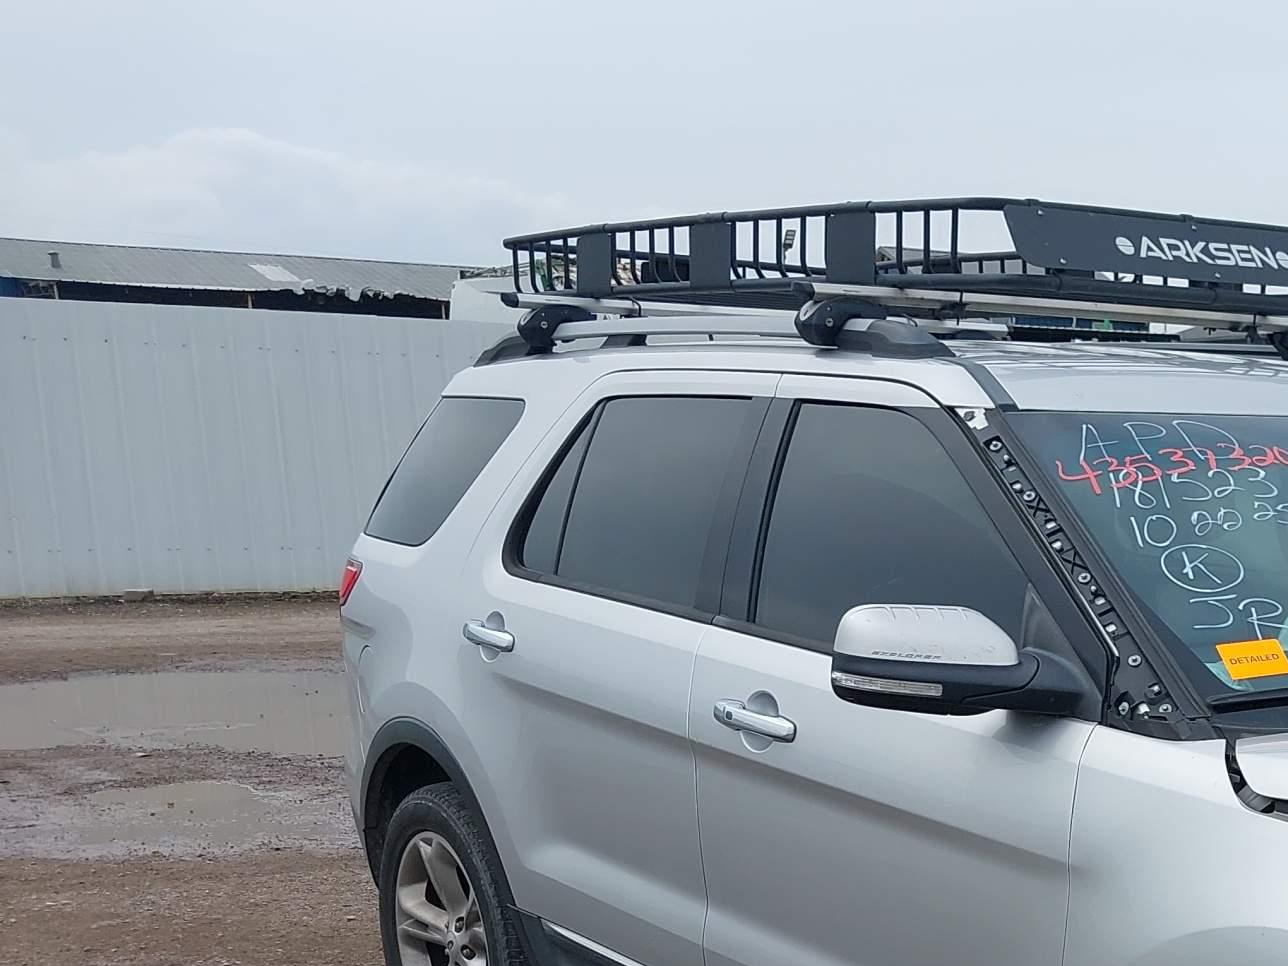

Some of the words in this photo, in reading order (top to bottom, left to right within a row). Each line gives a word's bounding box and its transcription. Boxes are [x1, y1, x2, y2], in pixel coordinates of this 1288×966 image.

[1139, 235, 1279, 269] ARKSEN
[1130, 514, 1177, 547] 10
[1182, 551, 1223, 585] K
[1229, 653, 1280, 665] DETAILED
